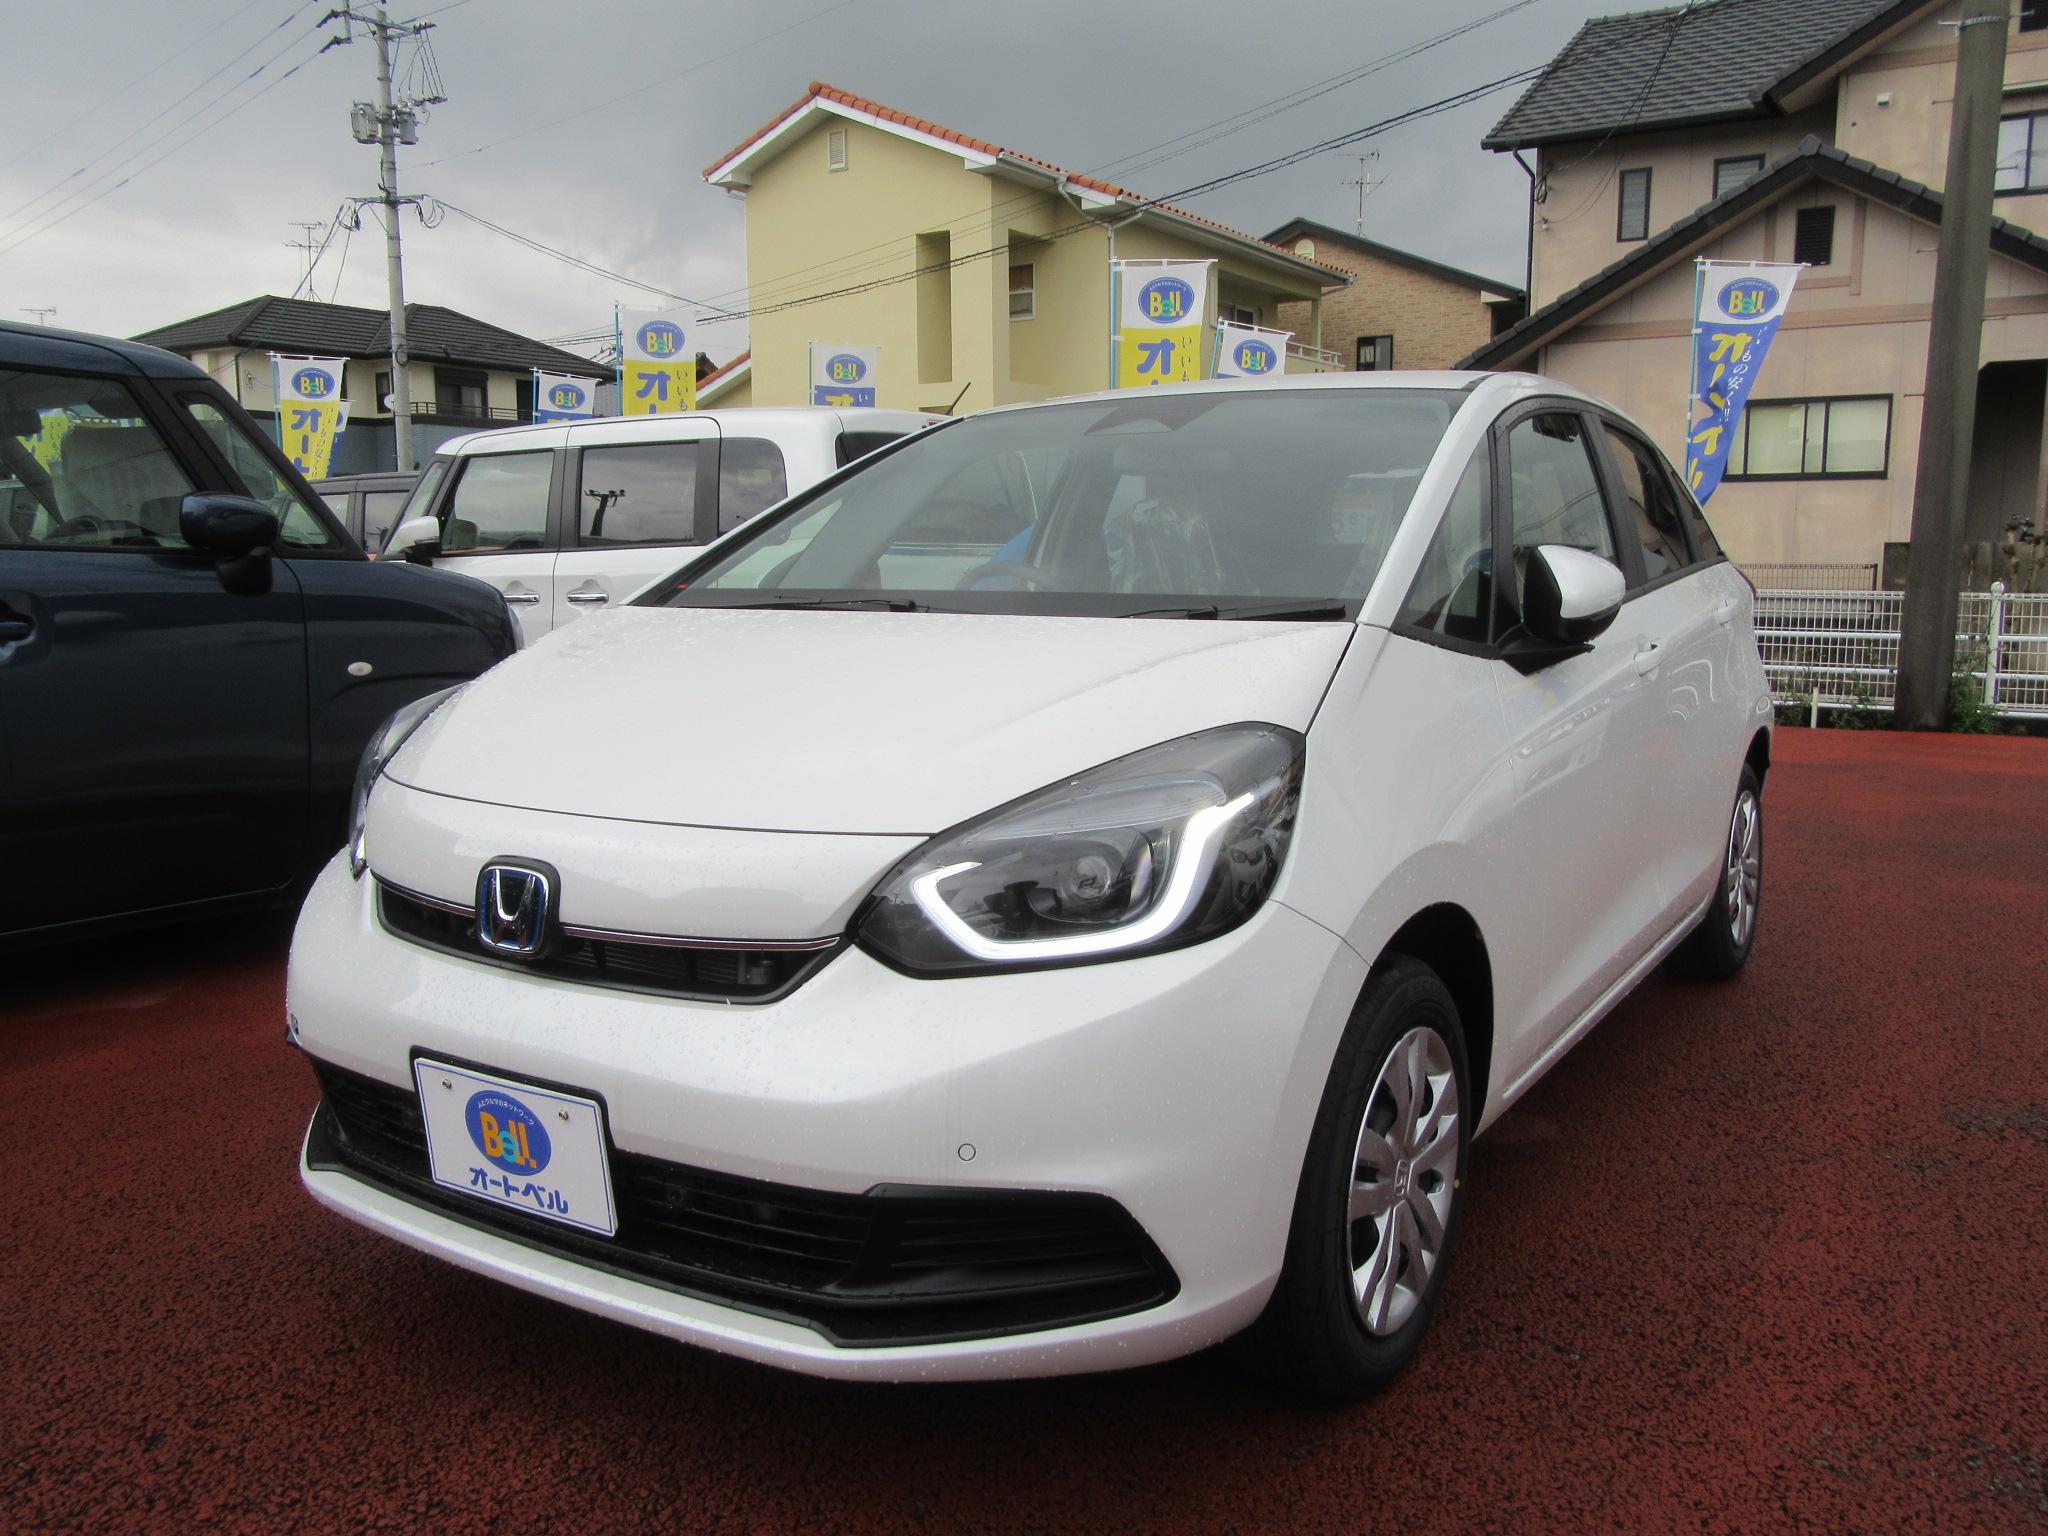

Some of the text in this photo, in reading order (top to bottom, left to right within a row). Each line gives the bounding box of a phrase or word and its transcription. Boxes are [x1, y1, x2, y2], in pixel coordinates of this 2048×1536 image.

[1136, 337, 1177, 386] オ
[469, 1166, 569, 1214] オートベル
